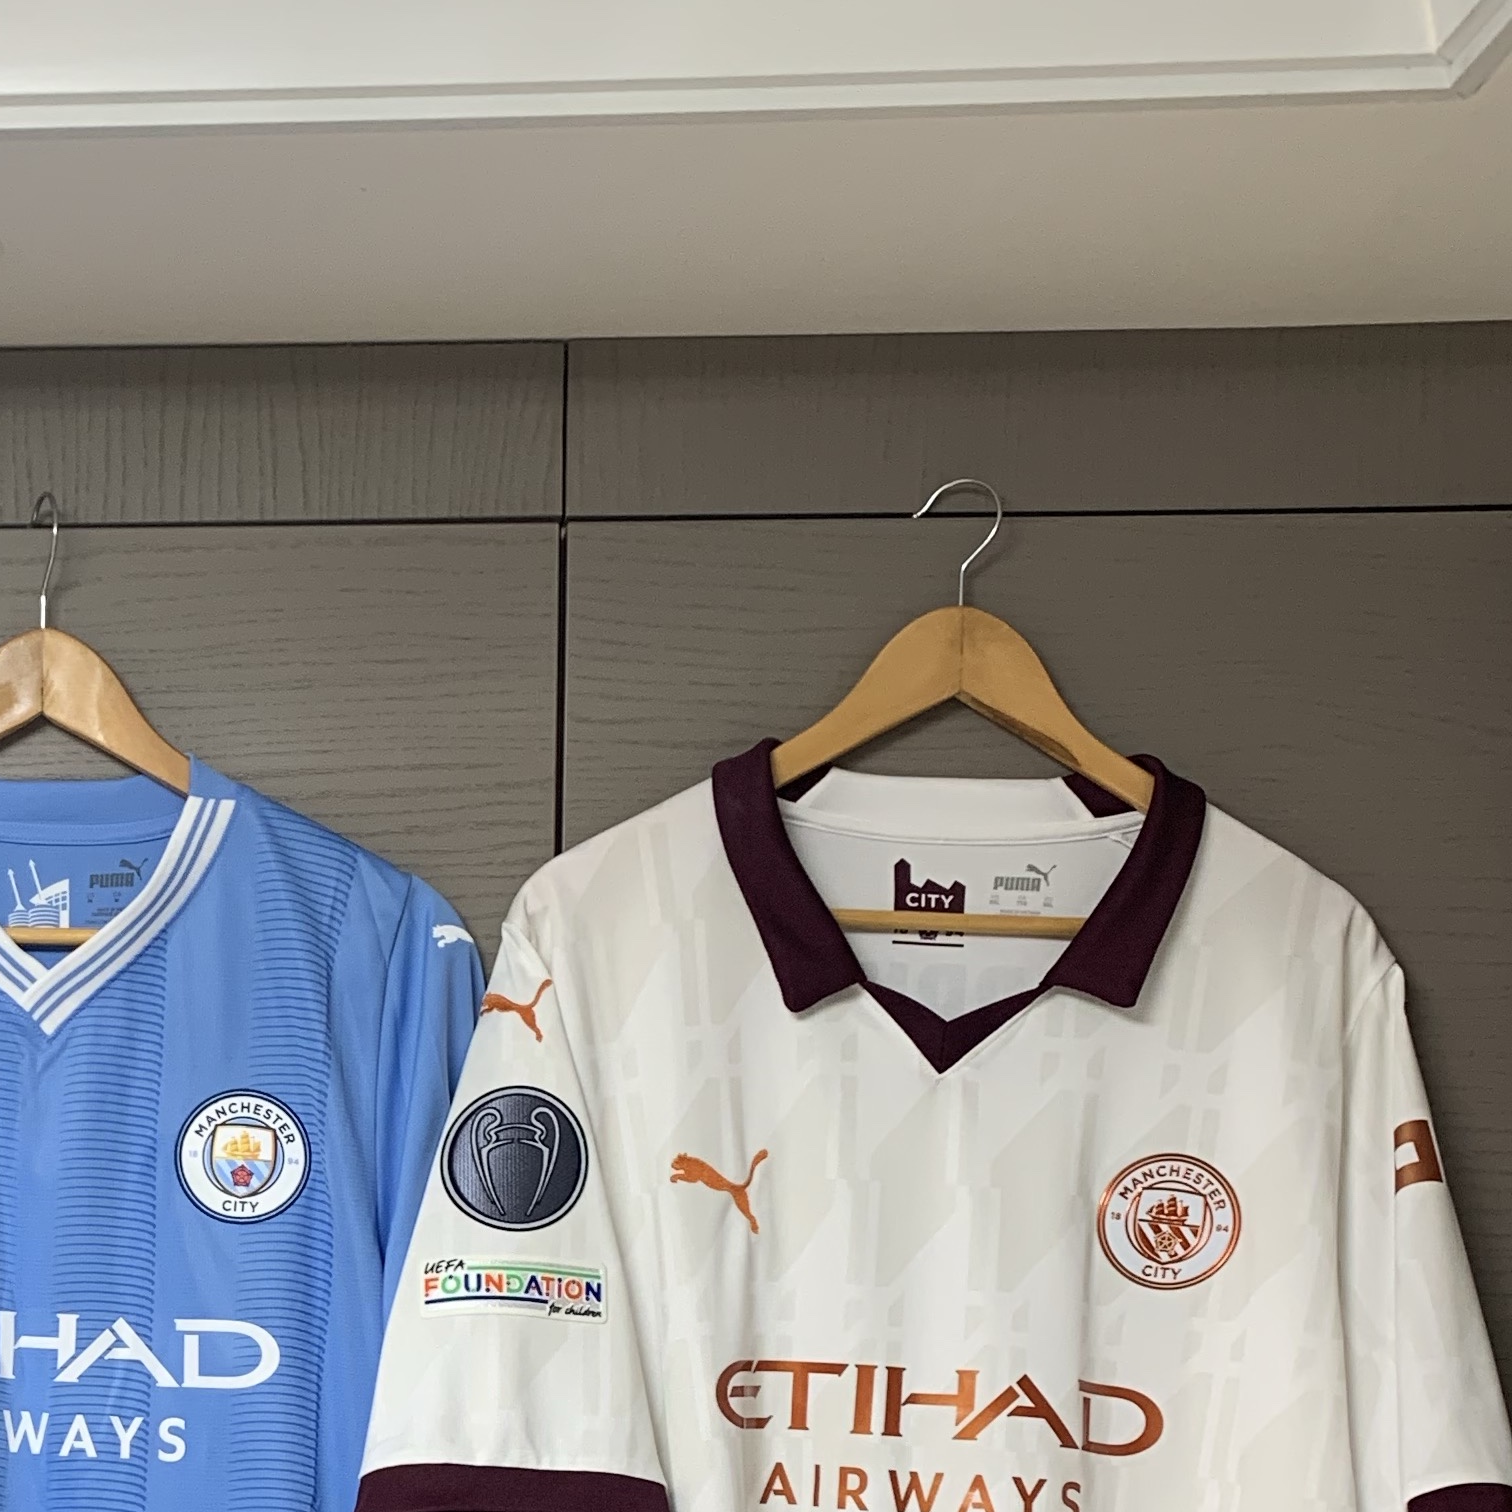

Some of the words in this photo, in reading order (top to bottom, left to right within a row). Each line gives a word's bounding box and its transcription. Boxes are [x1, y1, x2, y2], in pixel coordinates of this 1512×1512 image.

[89, 872, 134, 888] PUMA
[993, 876, 1041, 892] PUMA
[905, 893, 954, 909] CITY
[194, 1102, 296, 1145] MANCHESTER
[1118, 1165, 1227, 1211] MANCHESTER
[221, 1199, 259, 1213] CITY
[424, 1258, 466, 1275] UEFA
[1141, 1264, 1182, 1280] CITY
[424, 1272, 602, 1303] FOUNDATION
[548, 1302, 563, 1316] for
[565, 1303, 602, 1318] children
[715, 1359, 1165, 1457] ETIHAD
